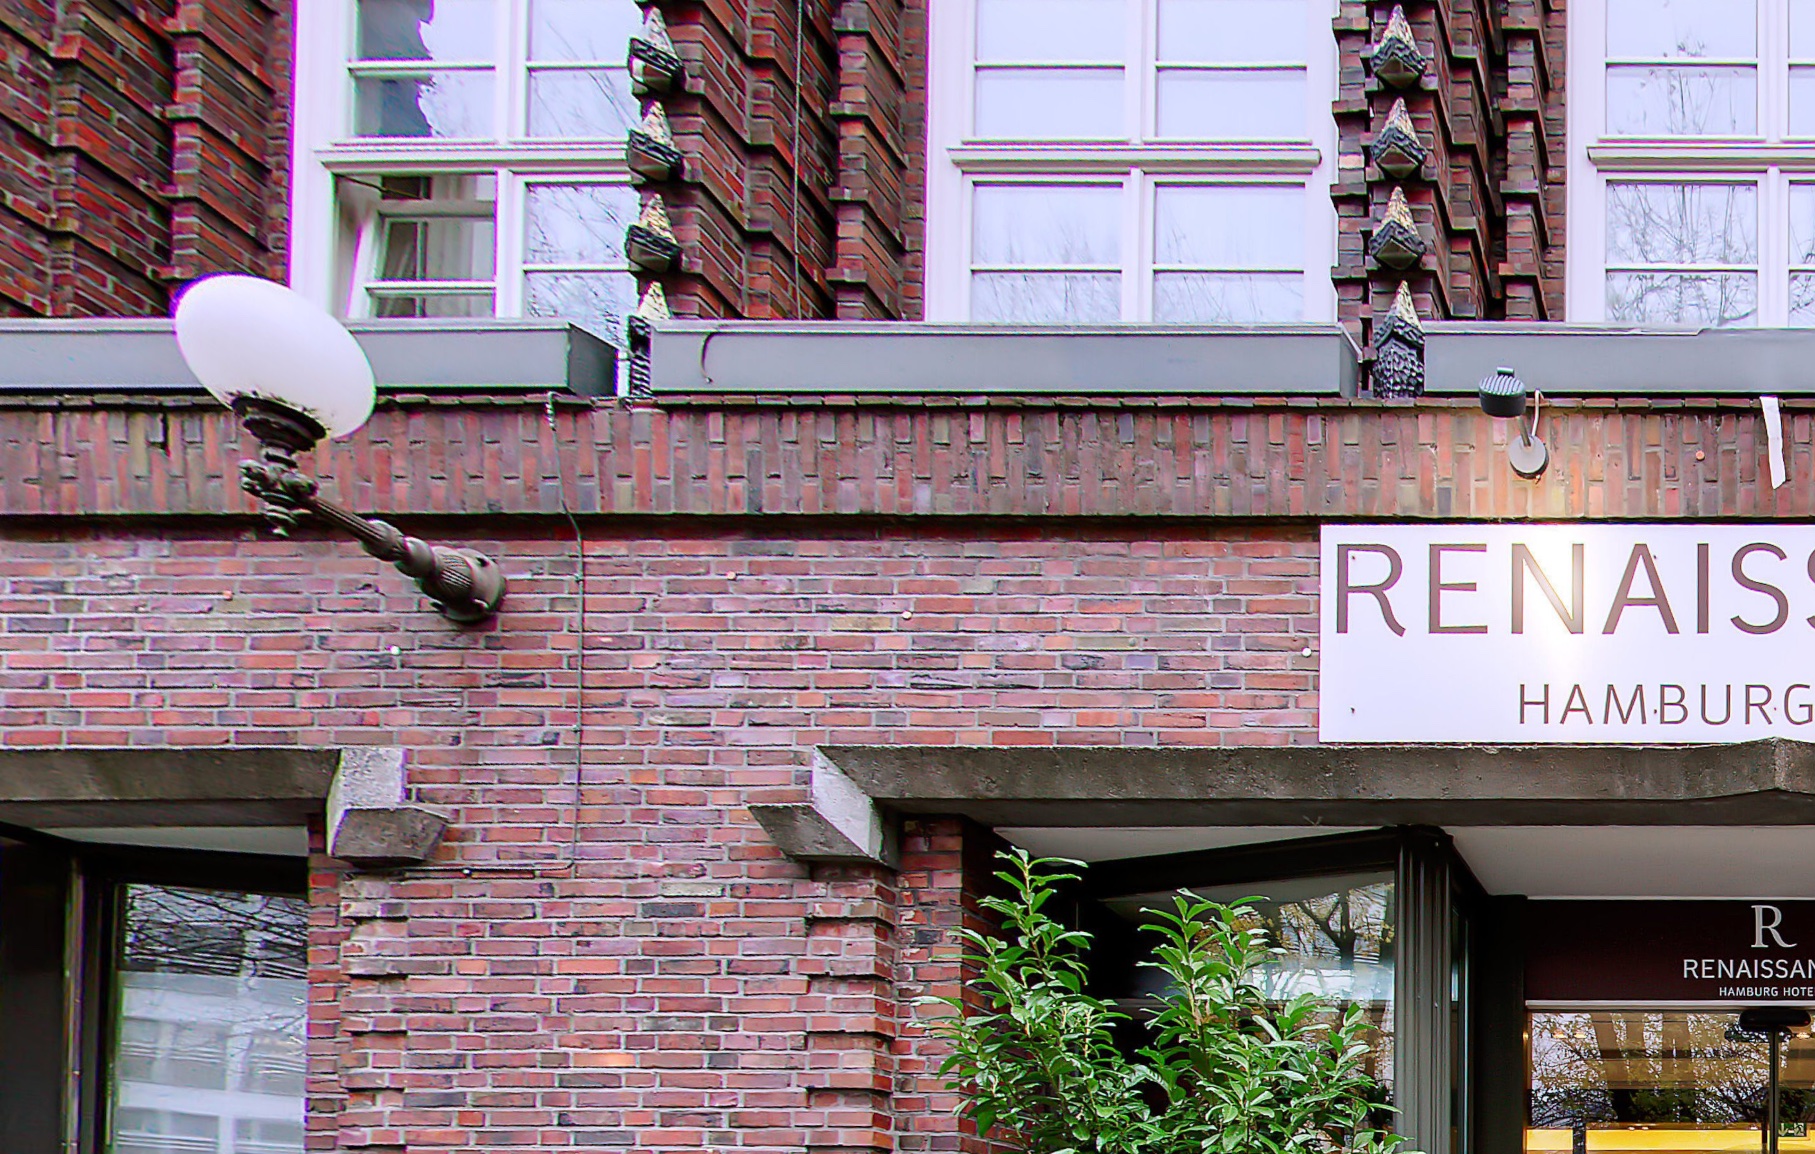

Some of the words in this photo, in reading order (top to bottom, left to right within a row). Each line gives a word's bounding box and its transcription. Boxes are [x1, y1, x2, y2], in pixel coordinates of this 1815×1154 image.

[1518, 683, 1815, 726] HAMBURG
[1751, 905, 1797, 948] R
[1719, 986, 1779, 997] HAMBURG
